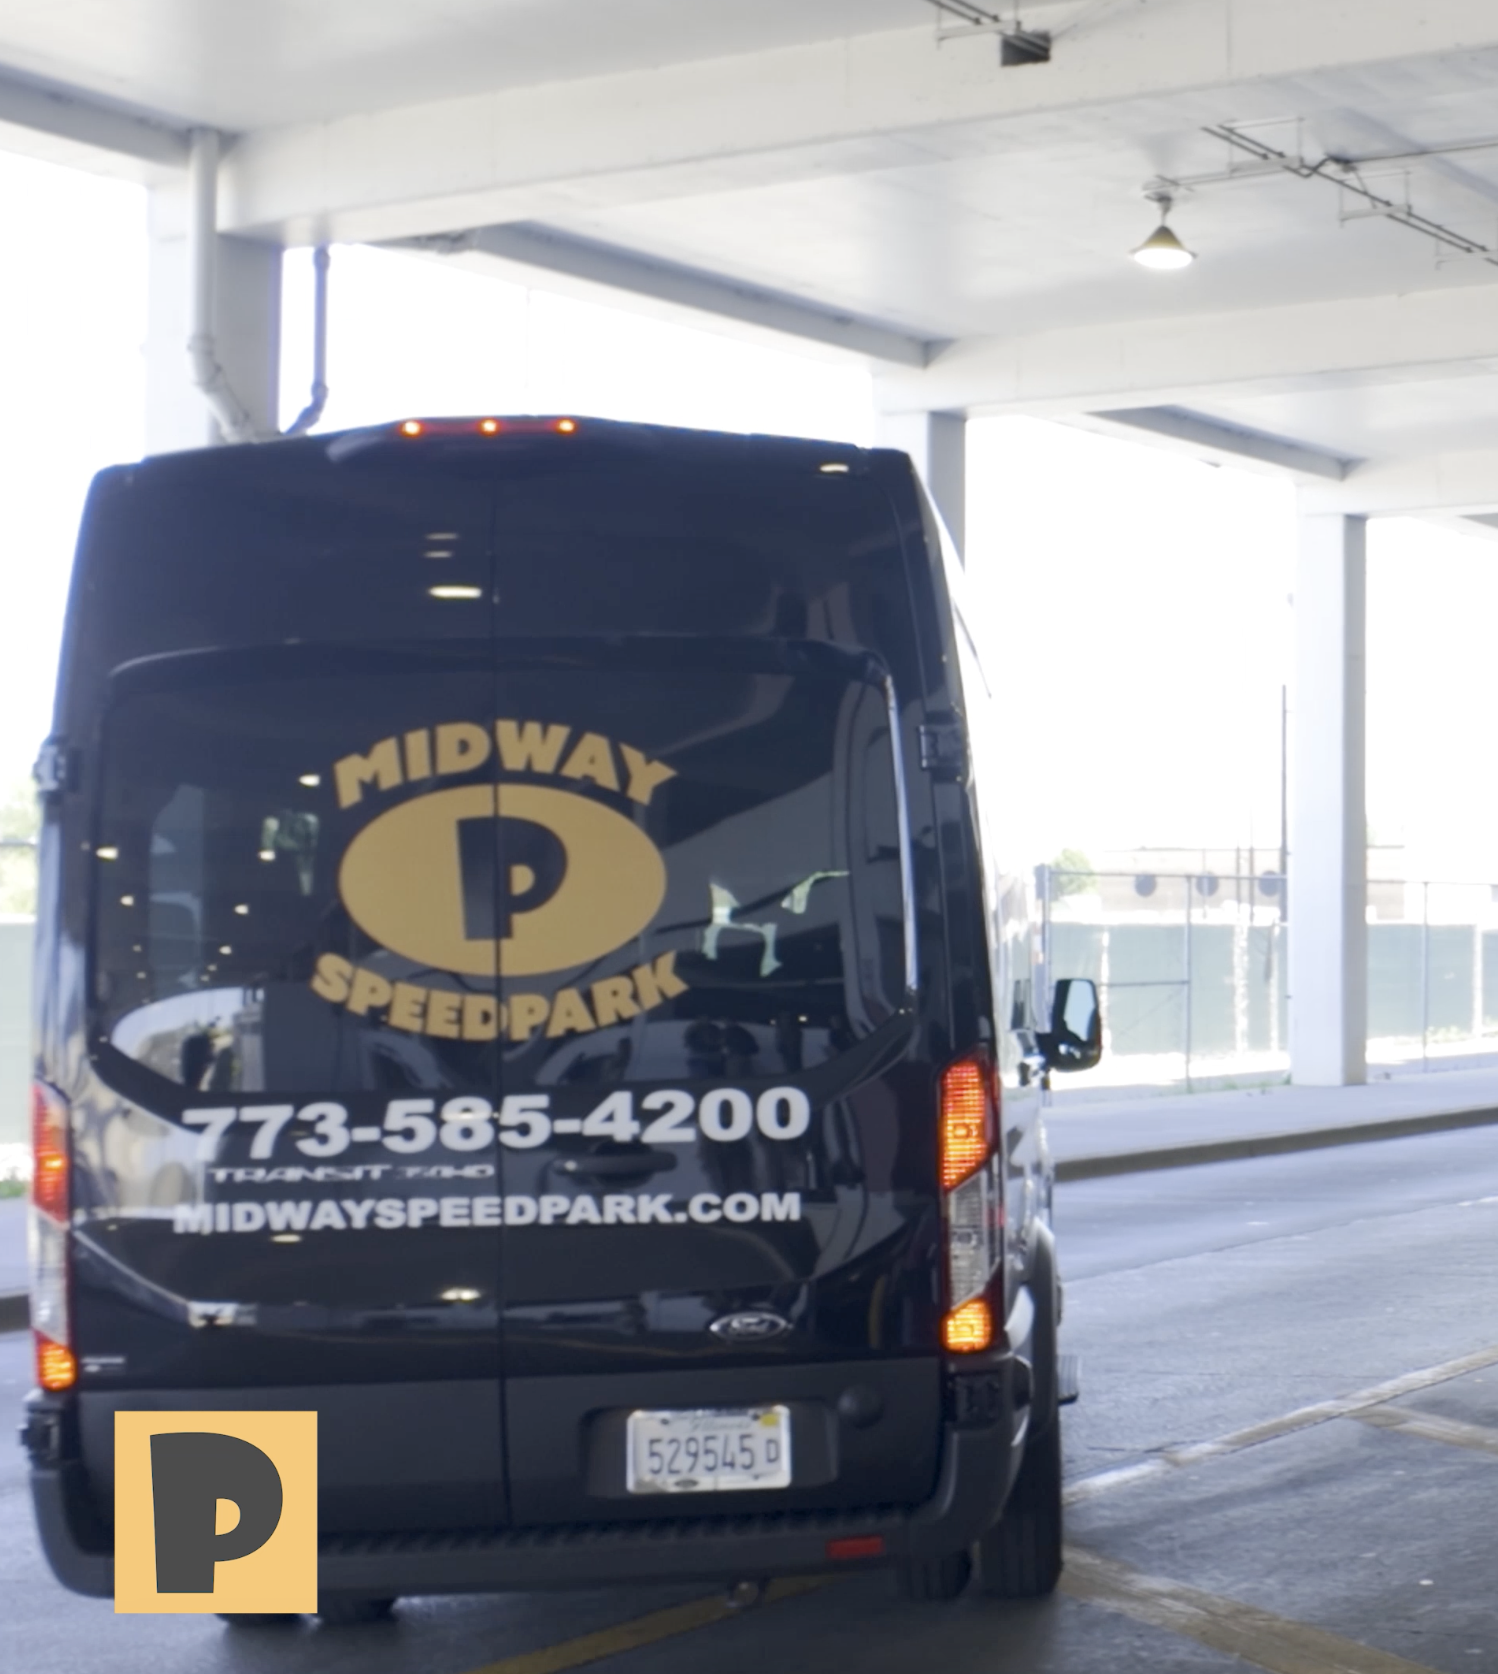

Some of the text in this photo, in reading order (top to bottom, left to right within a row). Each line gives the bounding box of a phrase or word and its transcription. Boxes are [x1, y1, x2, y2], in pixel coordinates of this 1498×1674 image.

[333, 718, 679, 810] MIDWAY
[455, 815, 569, 942] P
[310, 950, 689, 1042] SPEEDPARK
[181, 1086, 810, 1162] 773-585-4200
[207, 1163, 392, 1183] TRANSIT
[172, 1191, 801, 1235] MIDWAYSPEEDPARK.COM
[647, 1433, 779, 1476] 529545 D
